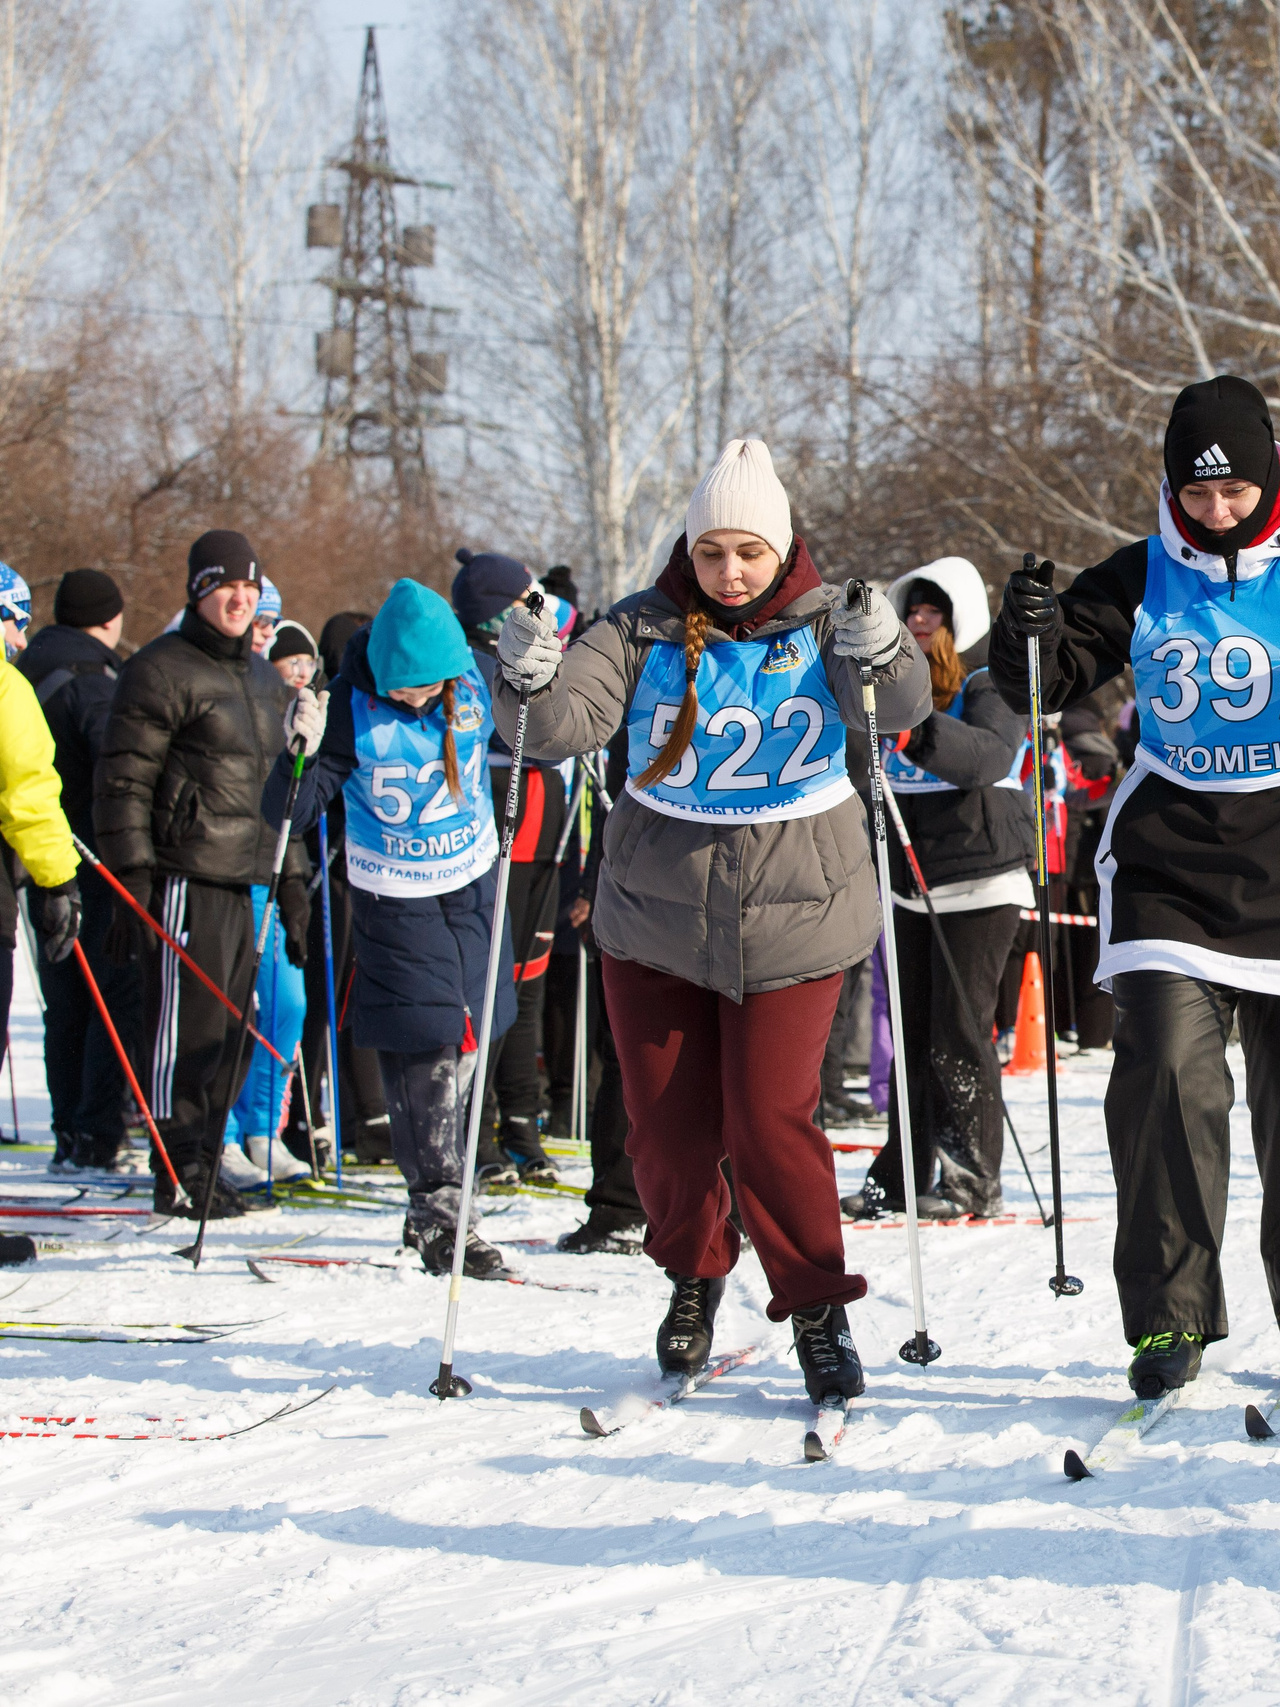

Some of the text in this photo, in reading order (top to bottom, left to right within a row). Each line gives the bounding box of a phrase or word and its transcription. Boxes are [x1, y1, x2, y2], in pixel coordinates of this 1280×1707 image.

[1194, 466, 1231, 477] adidas
[648, 696, 830, 791] 522
[372, 742, 483, 825] 521
[349, 854, 386, 876] КУБОК
[388, 867, 433, 881] ГЛАВЫ
[668, 1341, 689, 1350] 39
